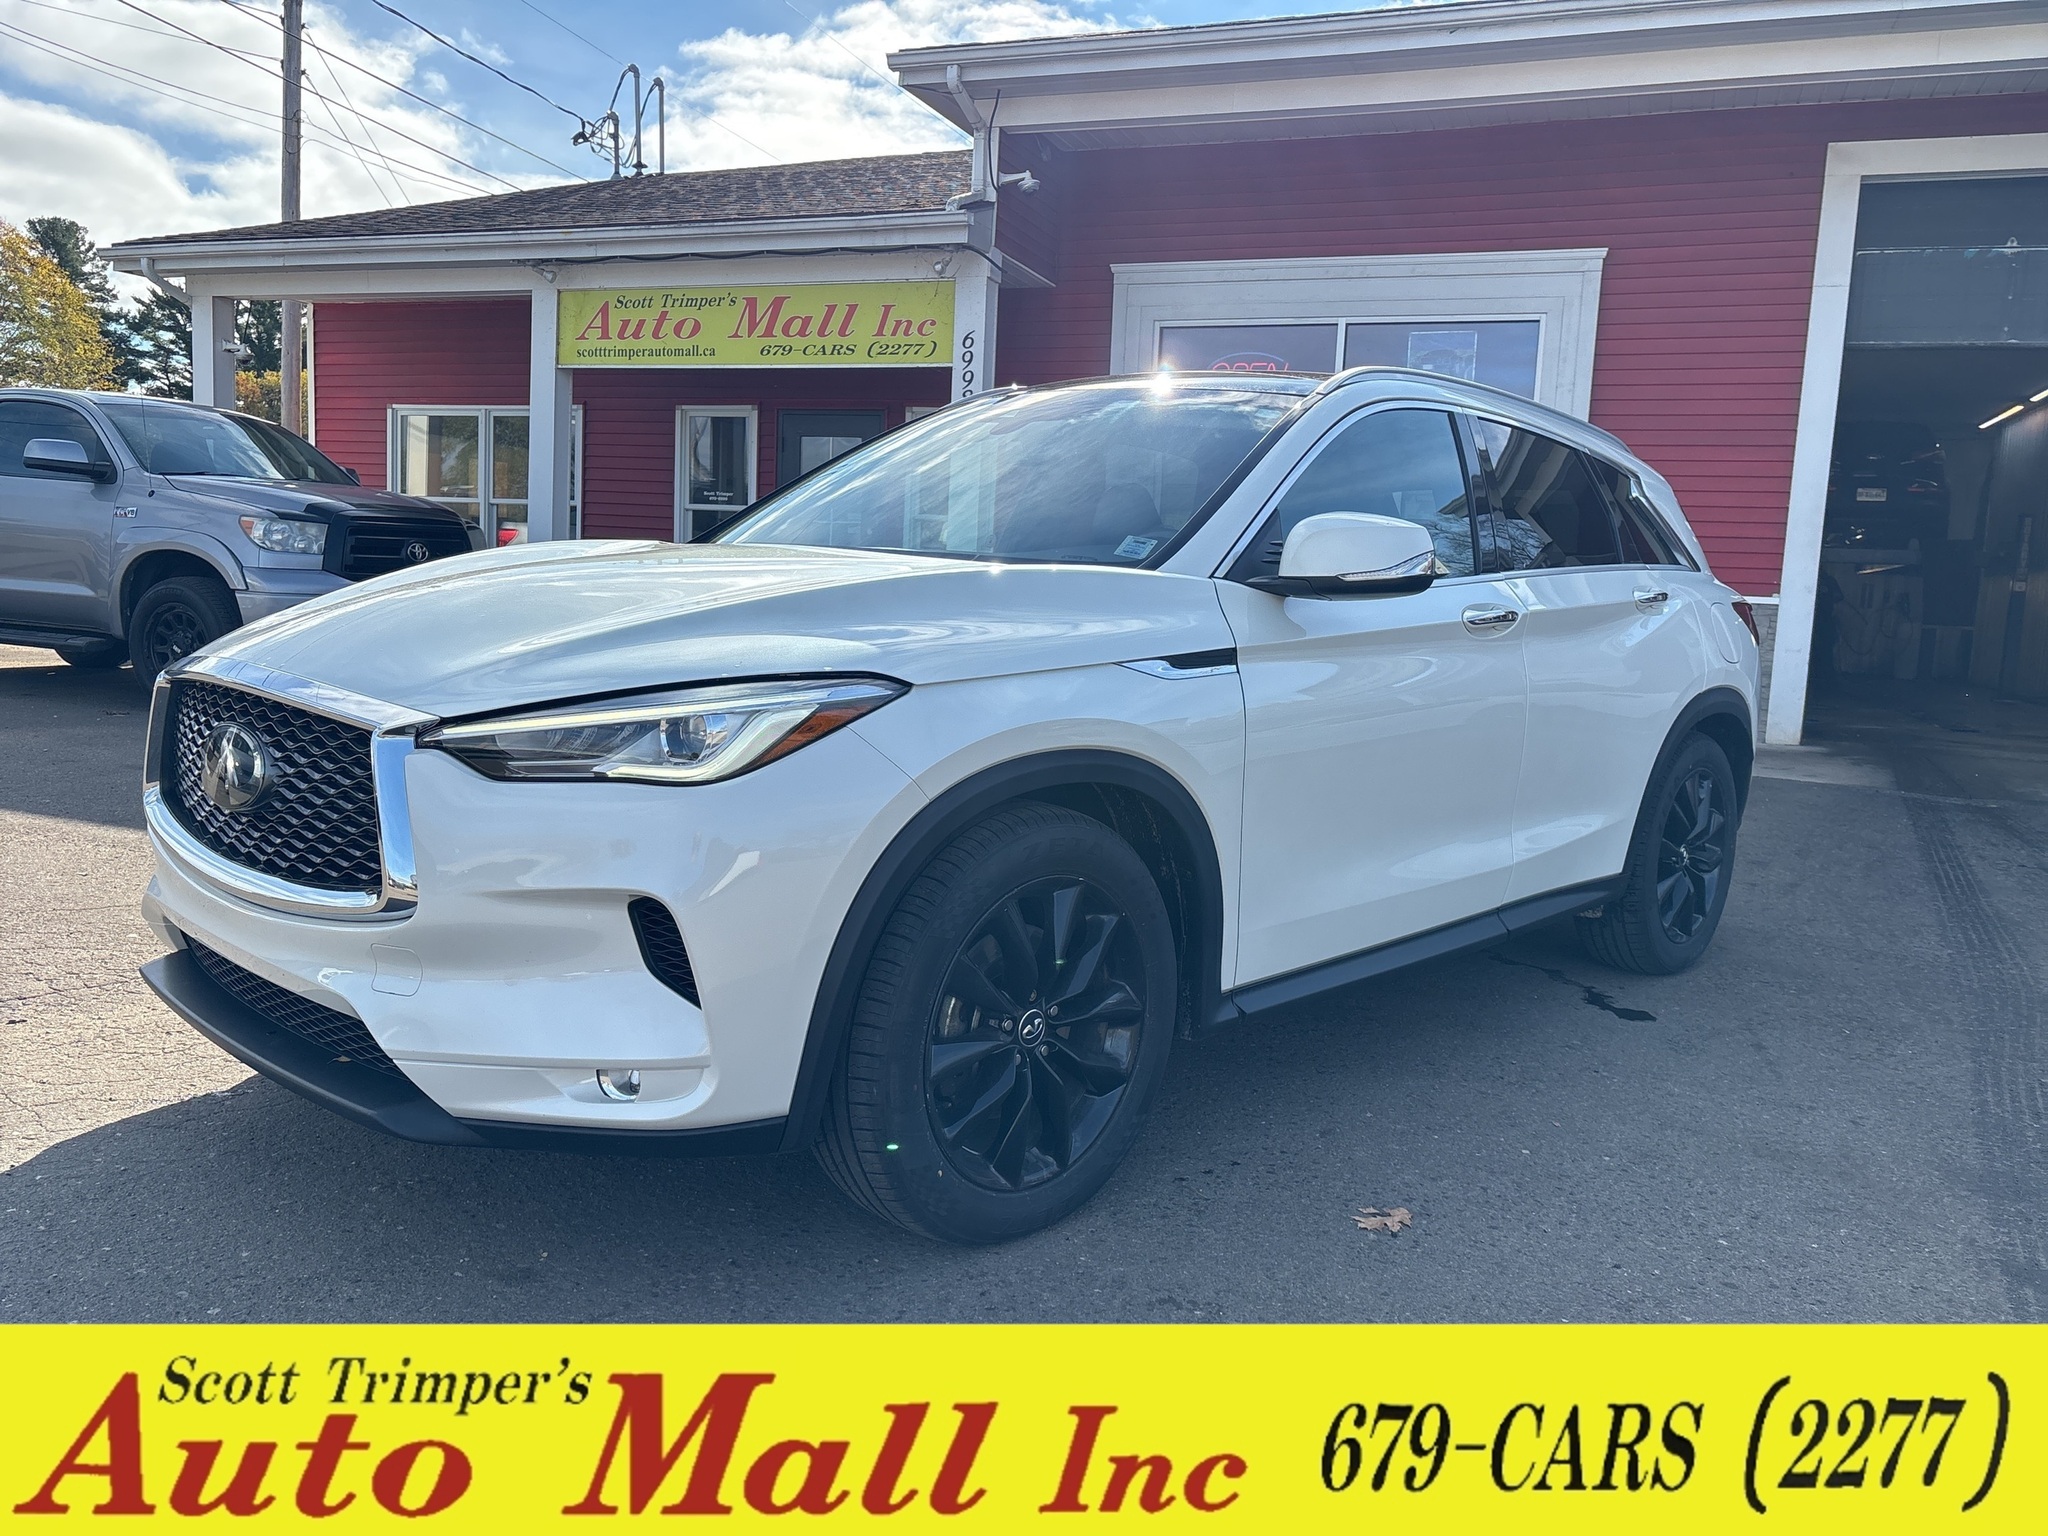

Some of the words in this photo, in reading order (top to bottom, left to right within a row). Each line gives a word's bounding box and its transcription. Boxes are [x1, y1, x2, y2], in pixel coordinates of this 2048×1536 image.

[614, 295, 654, 309] Scott
[661, 292, 738, 311] Trimper's
[575, 300, 702, 341] Auto
[727, 296, 859, 339] Mall
[872, 304, 937, 337] Inc
[576, 345, 716, 360] scotttrimperautomall.ca
[760, 343, 857, 356] 679-CARS
